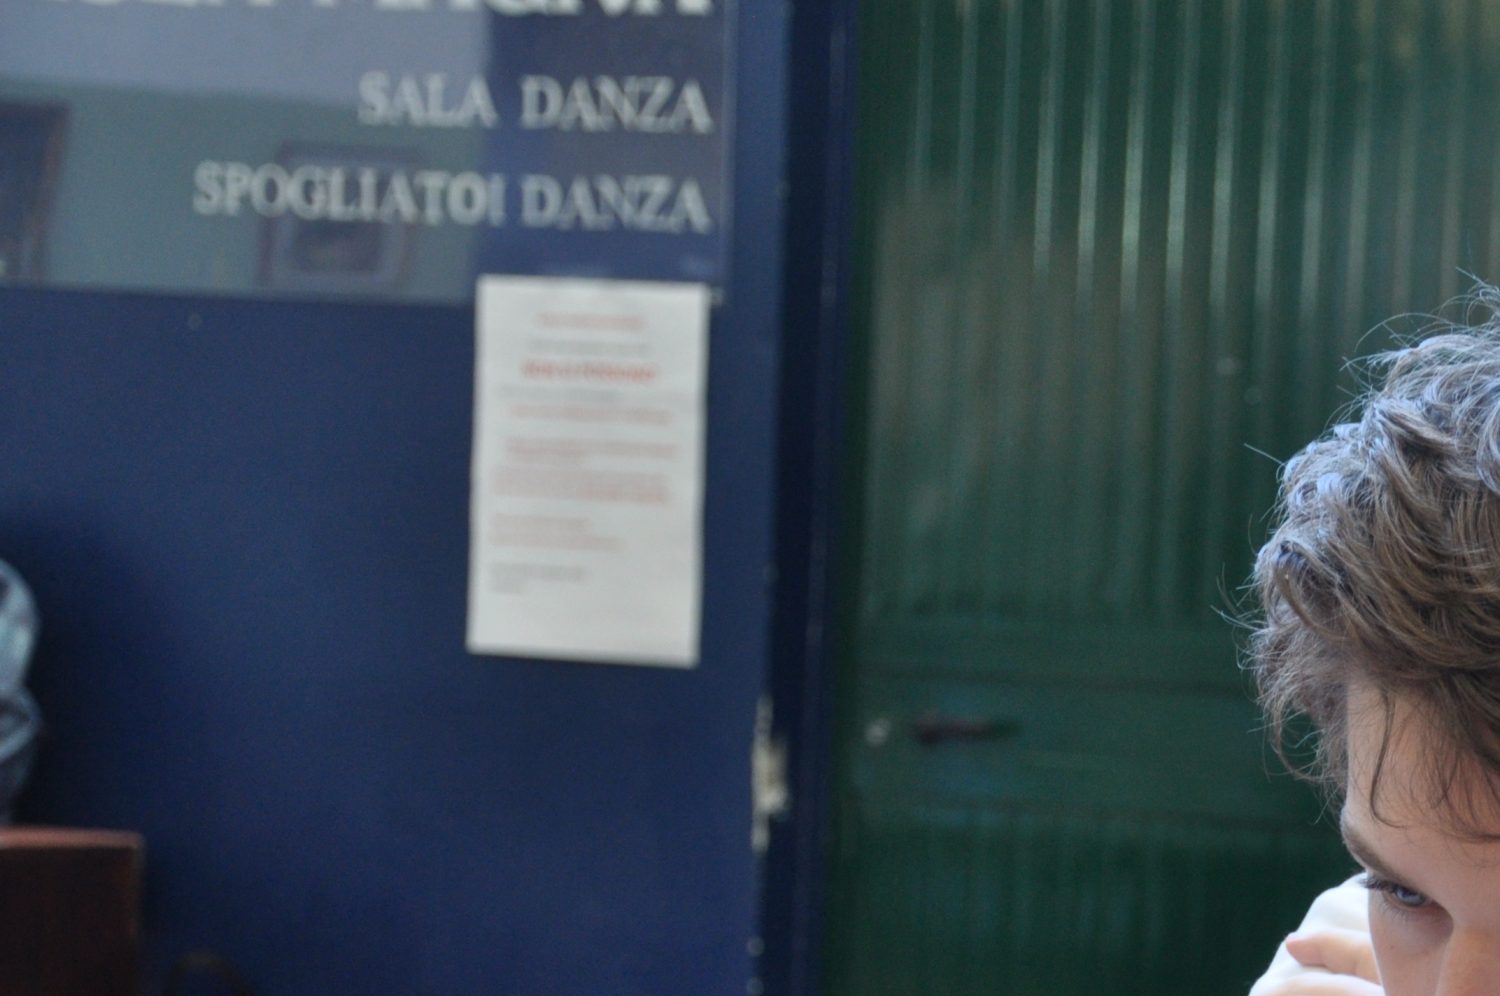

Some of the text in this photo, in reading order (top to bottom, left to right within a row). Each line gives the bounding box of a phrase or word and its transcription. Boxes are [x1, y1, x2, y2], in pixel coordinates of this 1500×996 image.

[357, 70, 714, 134] SALA DANZA
[193, 160, 714, 235] SPOGLIATOI DANZA
